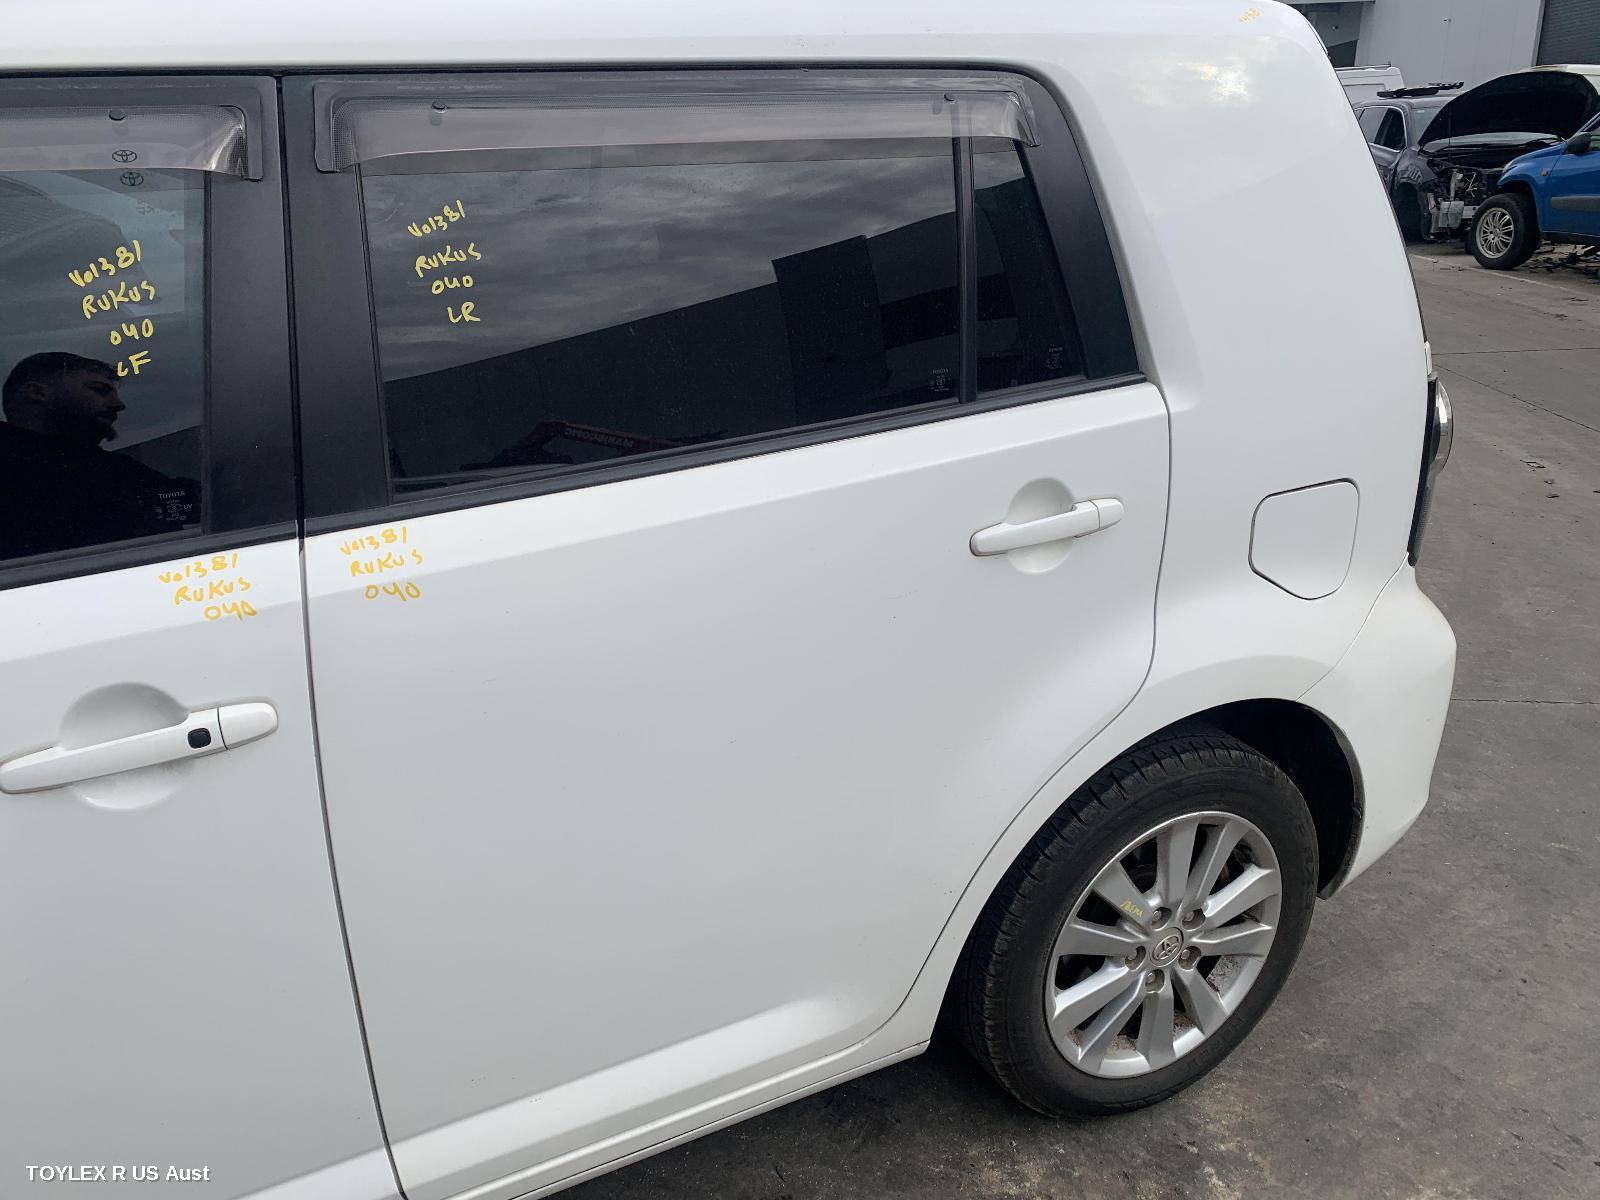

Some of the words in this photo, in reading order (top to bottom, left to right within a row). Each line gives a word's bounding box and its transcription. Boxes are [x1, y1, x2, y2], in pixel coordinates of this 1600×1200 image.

[415, 242, 482, 278] RUKUS
[82, 280, 156, 320] RUKUS
[447, 301, 481, 323] LR
[110, 318, 154, 346] 040
[117, 350, 152, 377] LF
[350, 548, 423, 577] RUKUS
[175, 576, 251, 605] RUKUS
[365, 581, 421, 602] 040
[204, 600, 257, 621] 040
